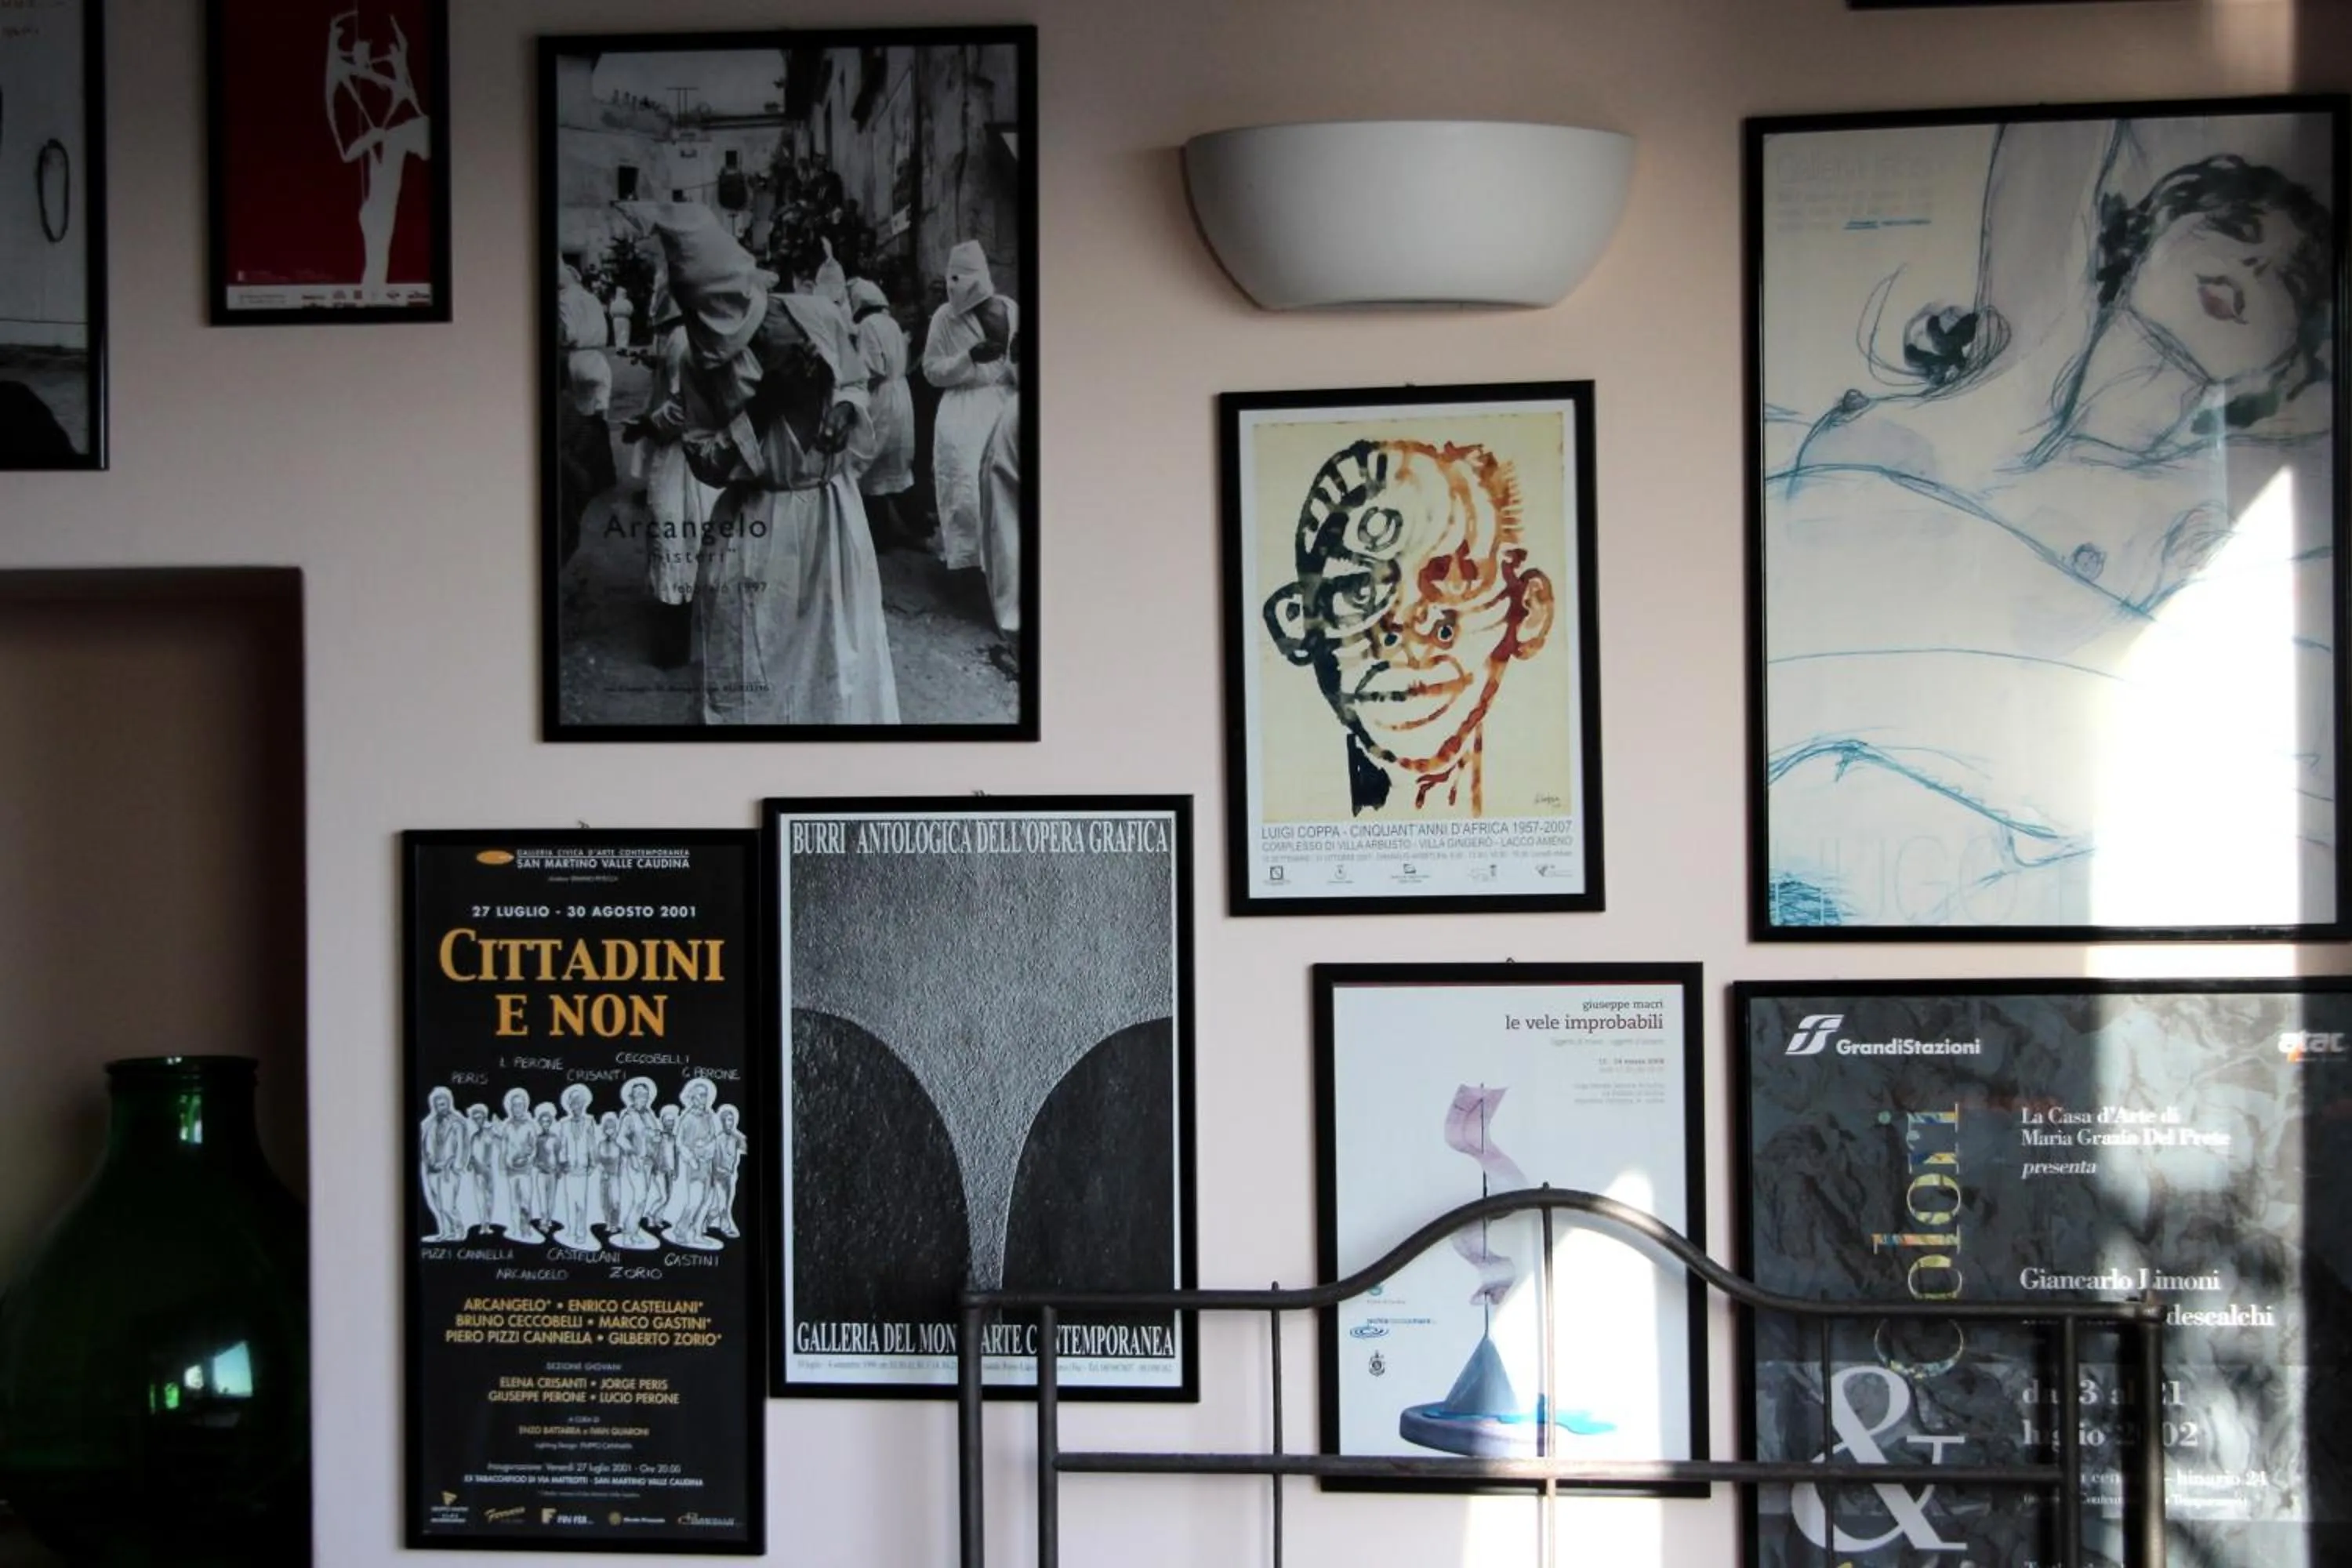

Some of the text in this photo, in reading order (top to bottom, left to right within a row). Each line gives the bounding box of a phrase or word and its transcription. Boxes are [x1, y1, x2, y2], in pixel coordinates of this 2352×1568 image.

[604, 513, 768, 546] Arcangelo
[793, 820, 1169, 855] BURRI ANTOLOGICA DELL'OPERA GRAFICA
[1261, 826, 1294, 840] LUIGI
[1298, 826, 1340, 838] COPPA
[1450, 822, 1509, 836] D'AFRICA
[1512, 820, 1573, 834] 1957-2007
[1261, 841, 1323, 852] COMPLESSO
[1325, 840, 1335, 851] DI
[1338, 840, 1364, 851] VILLA
[1417, 837, 1446, 849] VILLA
[517, 858, 691, 869] SAN MARTINO VALLE CAUDINA
[471, 905, 490, 917] 27
[495, 905, 550, 917] LUGLIO
[566, 905, 586, 917] 30
[591, 905, 655, 918] AGOSTO
[659, 905, 696, 917] 2001
[439, 927, 725, 982] CITTADINI
[1582, 999, 1630, 1012] giuseppe
[495, 993, 669, 1038] E NON
[1505, 1014, 1664, 1033] le vele improbabili
[1835, 1038, 1982, 1055] GrandiStazioni
[513, 1056, 564, 1071] PERONE
[451, 1070, 490, 1085] PERIS
[2020, 1106, 2182, 1123] La Casa d'Arte di
[2020, 1128, 2073, 1146] Maria
[2142, 1128, 2176, 1146] Del
[2020, 1160, 2097, 1180] presenta
[608, 1265, 663, 1280] ZORIO
[2019, 1266, 2134, 1291] Giancarlo
[567, 1299, 619, 1313] ENRICO
[455, 1313, 506, 1328] BRUNO
[507, 1314, 583, 1329] CECCOBELLI
[597, 1315, 649, 1330] MARCO
[2165, 1305, 2276, 1327] descalchi
[445, 1329, 485, 1344] PIERO
[487, 1329, 520, 1344] PIZZI
[522, 1330, 593, 1345] CANNELLA
[608, 1330, 671, 1346] GILBERTO
[797, 1322, 880, 1353] GALLERIA
[883, 1323, 916, 1353] DEL
[919, 1323, 957, 1354] MON
[1025, 1325, 1174, 1356] CTEMPORANEA
[499, 1376, 670, 1391] ELENA CRISANTI JORGE PERIS
[487, 1389, 681, 1405] GIUSEPPE PERONE LUCIO PERONE
